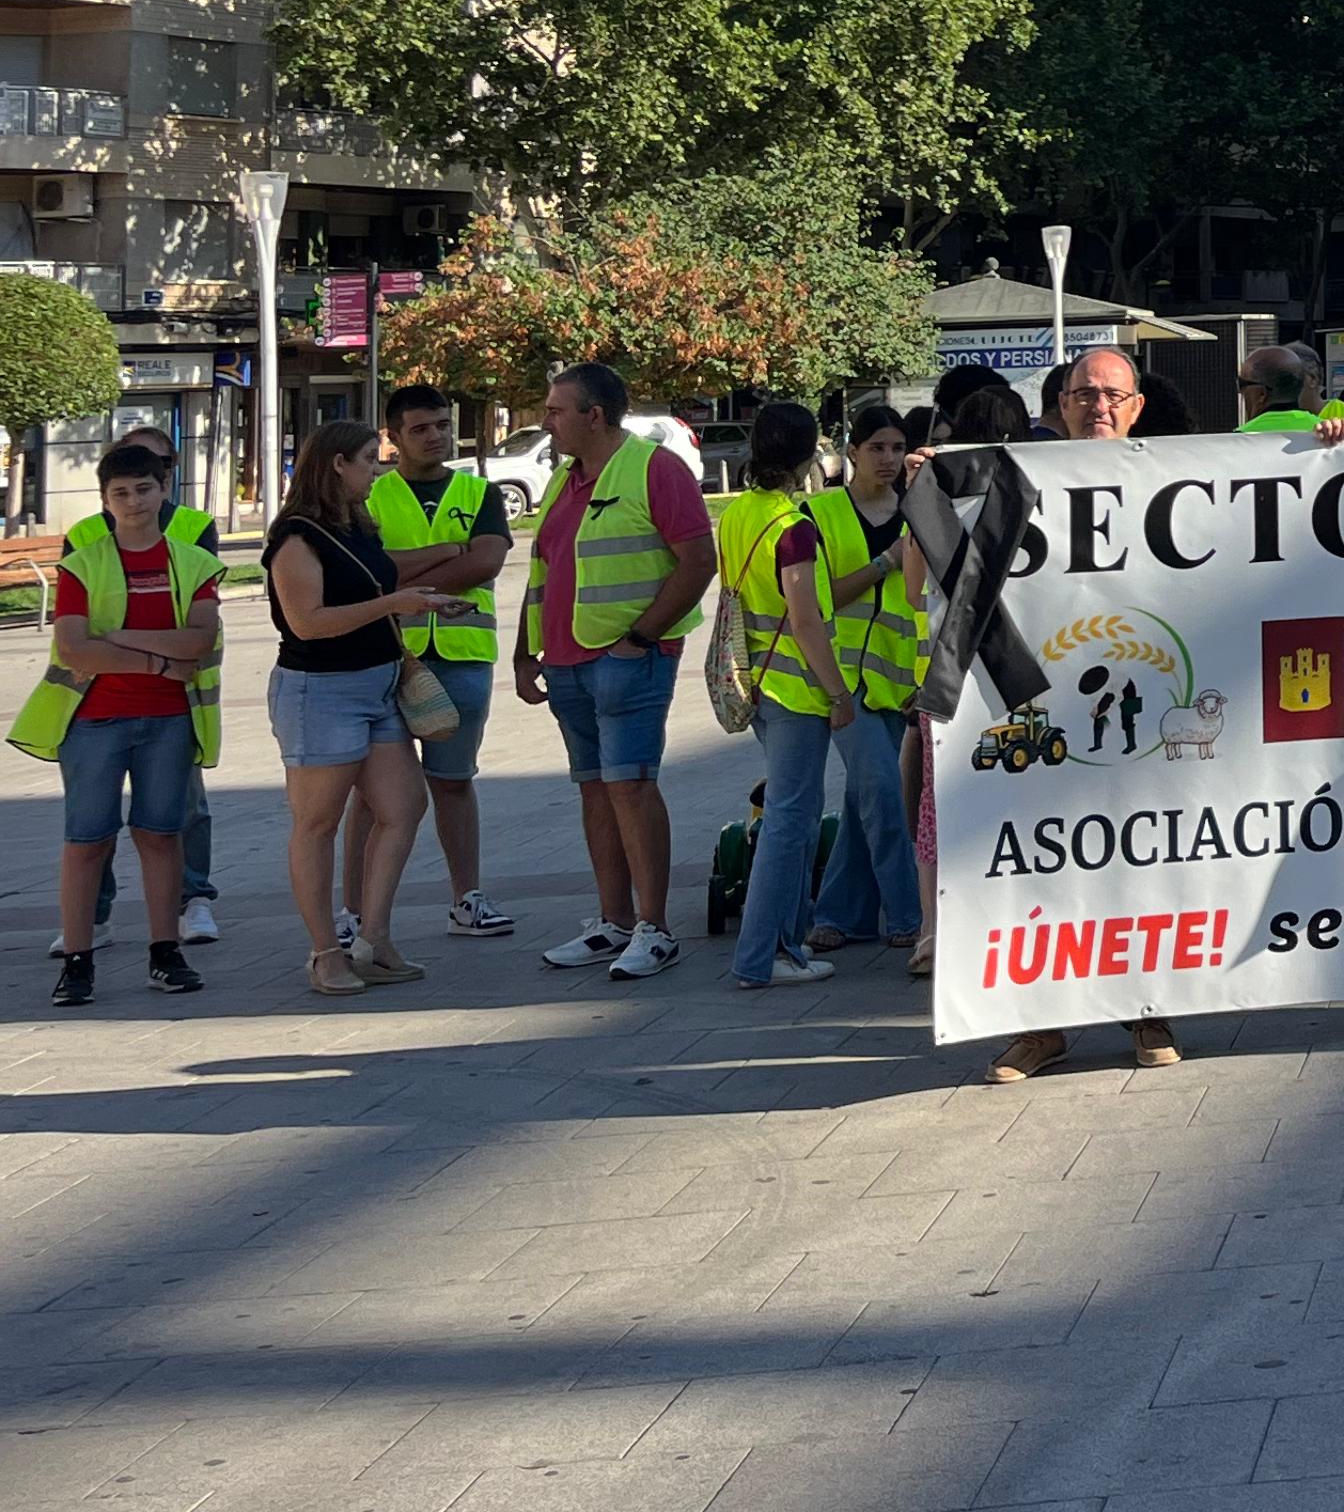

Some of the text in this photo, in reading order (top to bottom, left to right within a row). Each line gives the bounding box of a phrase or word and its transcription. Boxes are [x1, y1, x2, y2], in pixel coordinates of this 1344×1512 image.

[137, 359, 172, 369] REALE
[984, 351, 996, 368] Y
[983, 906, 1229, 988] ¡ÚNETE!
